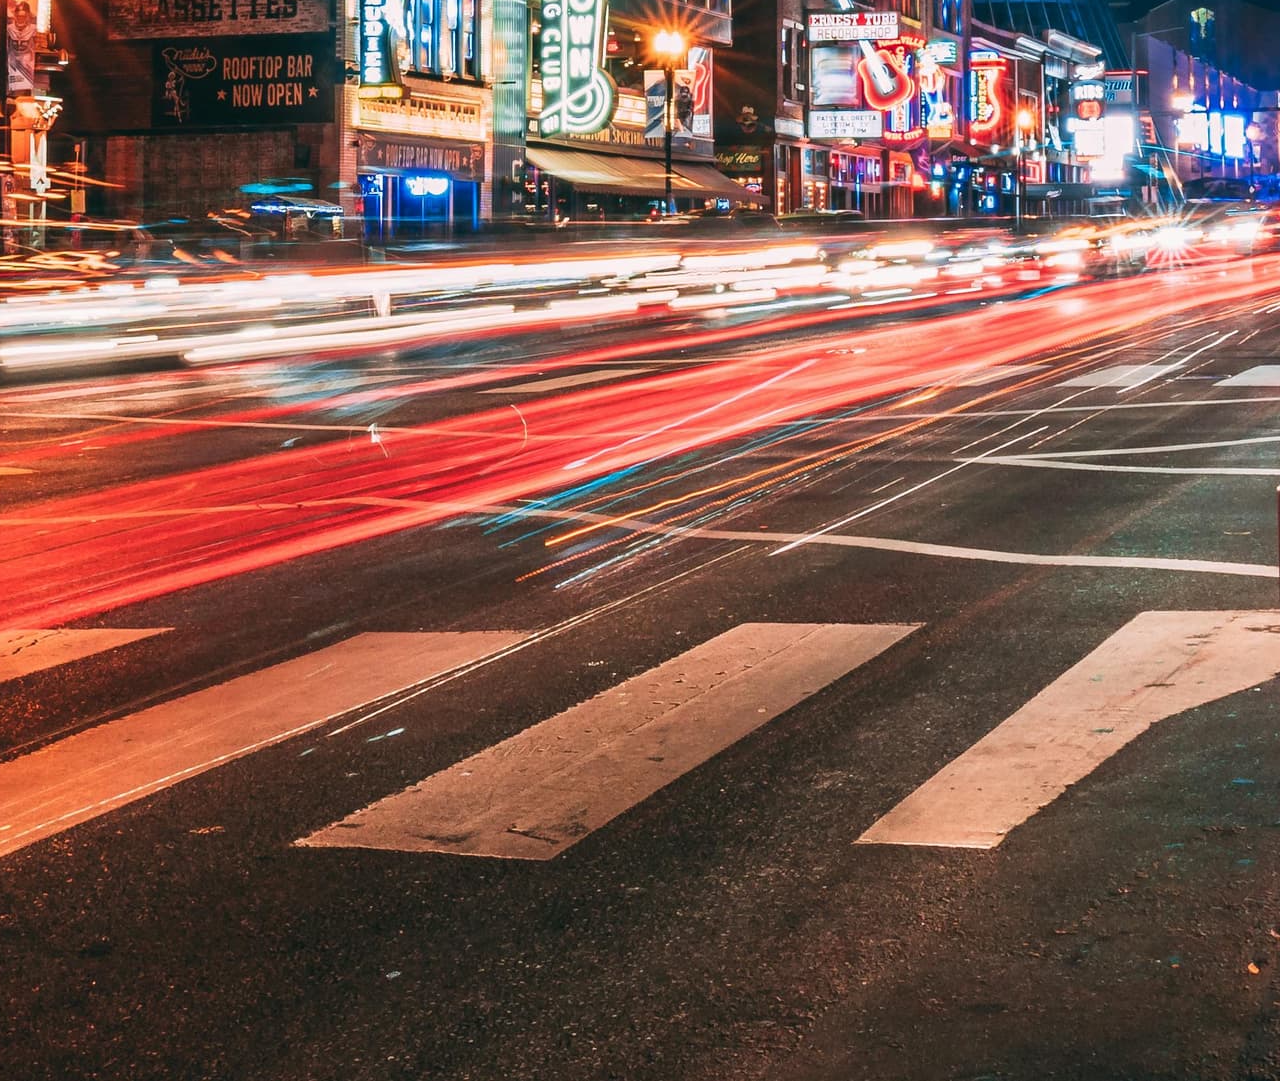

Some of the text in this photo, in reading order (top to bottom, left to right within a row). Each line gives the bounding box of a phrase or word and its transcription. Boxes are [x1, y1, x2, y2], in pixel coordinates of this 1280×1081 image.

[809, 14, 859, 26] ERNEST
[817, 27, 892, 40] RECORD SHOP
[223, 56, 283, 80] ROOFTOP
[287, 54, 314, 78] BAR
[541, 32, 562, 91] CLUB
[232, 82, 303, 108] NOW OPEN
